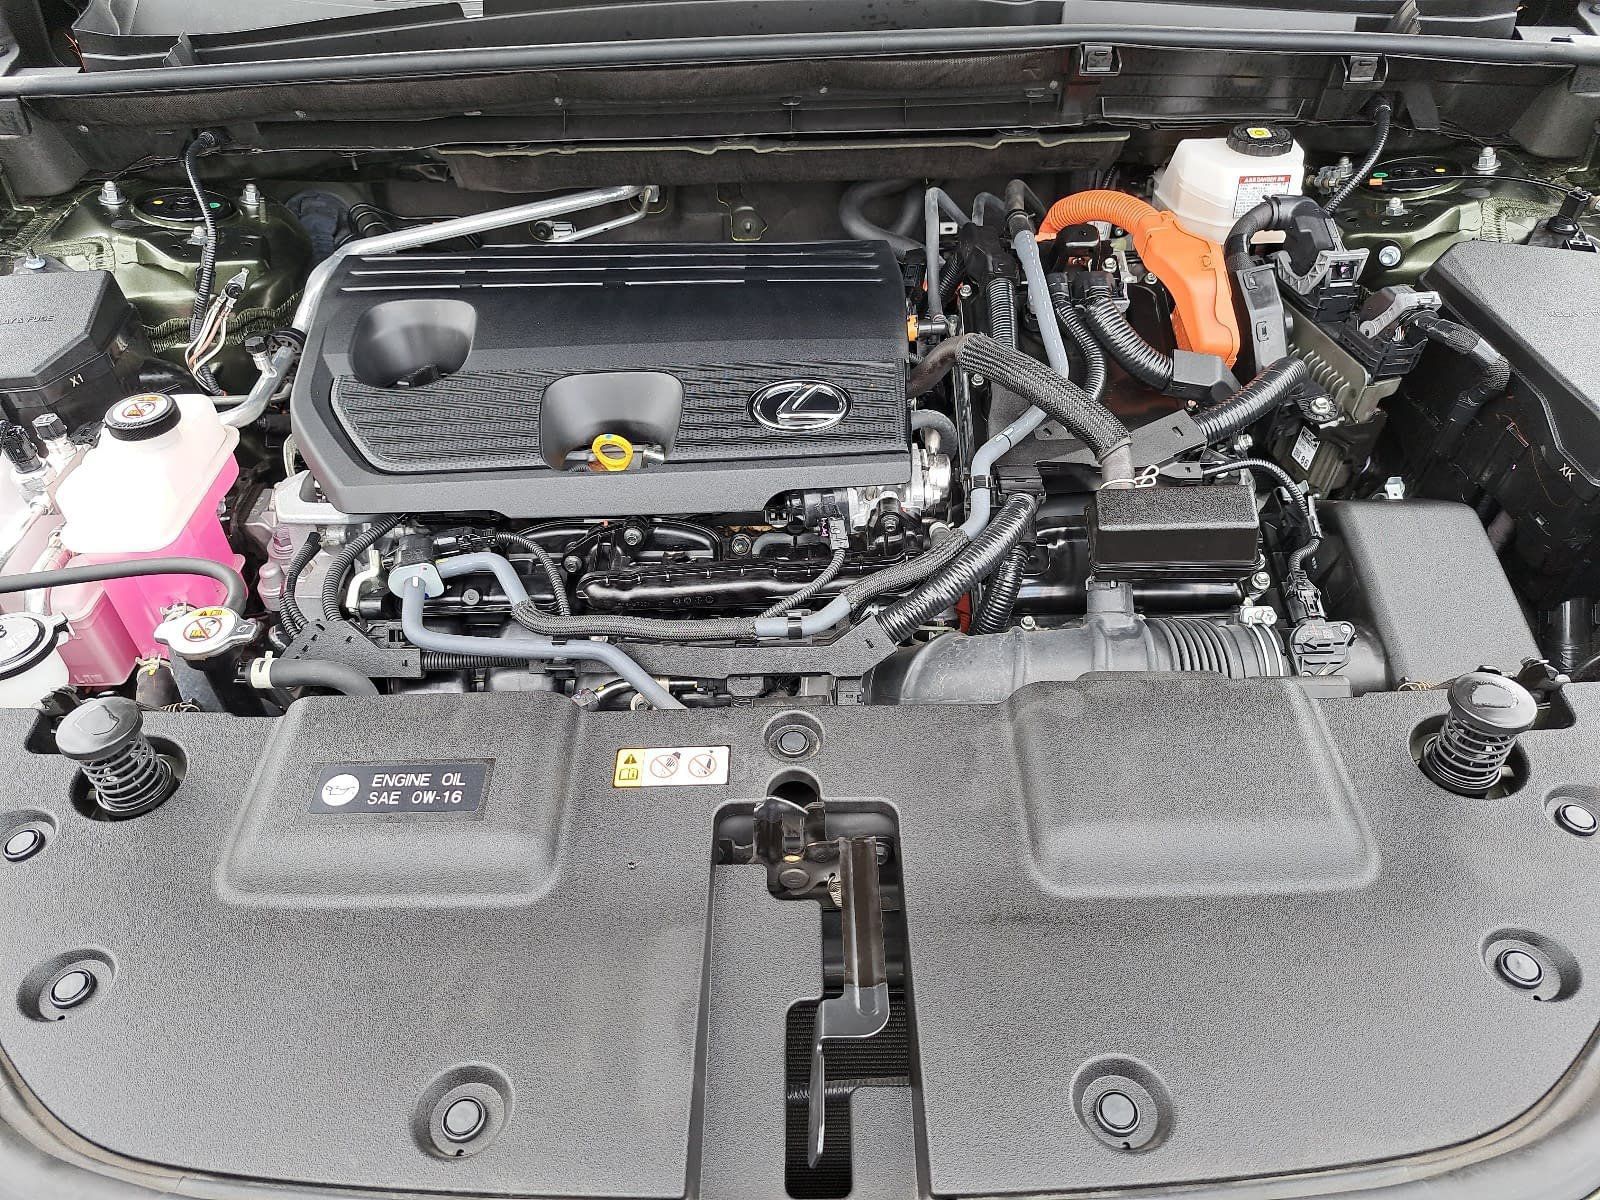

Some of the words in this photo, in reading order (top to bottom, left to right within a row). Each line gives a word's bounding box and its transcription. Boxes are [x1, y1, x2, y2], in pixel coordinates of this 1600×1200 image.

[69, 373, 84, 388] X1
[1558, 462, 1577, 482] XK
[371, 773, 432, 787] ENGINE
[441, 772, 466, 786] OIL
[367, 791, 402, 805] SAE
